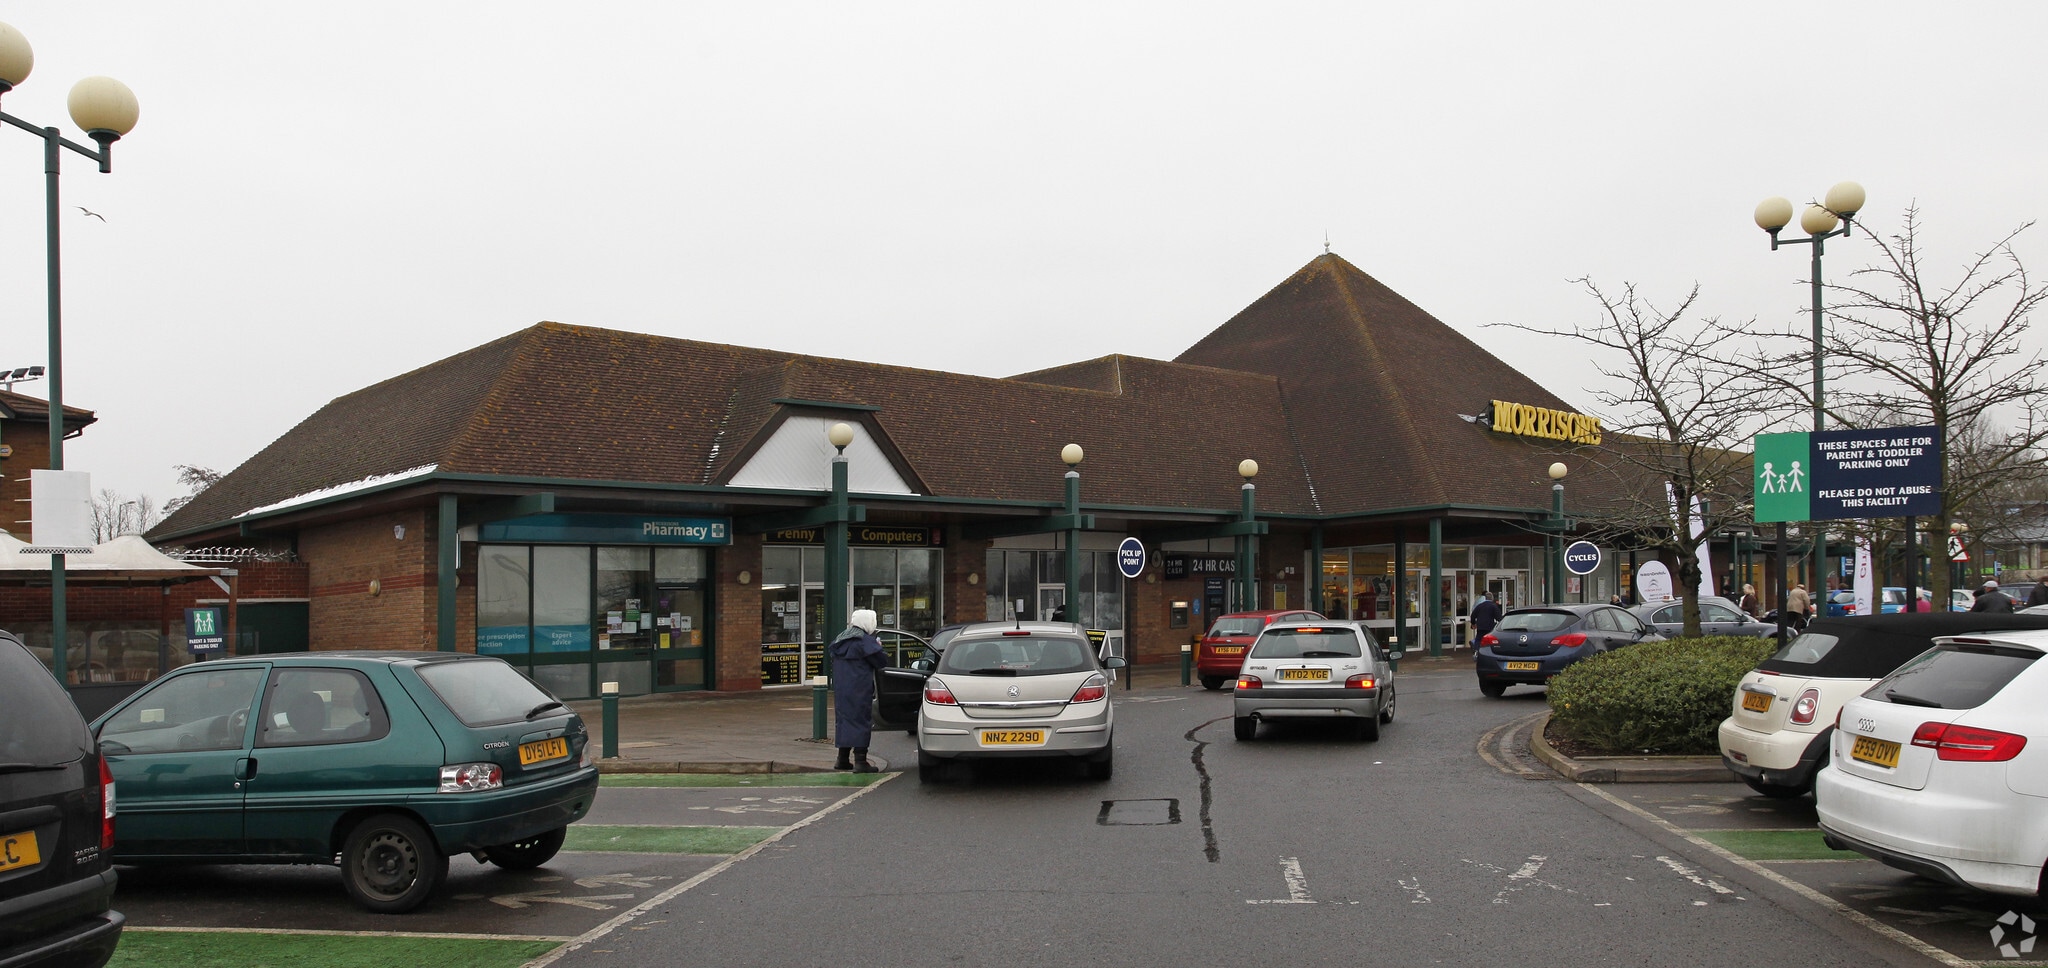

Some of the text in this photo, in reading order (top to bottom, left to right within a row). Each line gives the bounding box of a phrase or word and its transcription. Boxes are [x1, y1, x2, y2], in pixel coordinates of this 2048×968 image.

[1492, 399, 1602, 446] MORRISONS
[1818, 437, 1932, 451] THESE SPACES ARE FOR
[1826, 448, 1923, 460] PARENT & TODDLER
[1839, 458, 1910, 470] PARKING ONLY
[1818, 485, 1932, 499] PLEASE DO NOT ABUSE
[1841, 496, 1909, 508] THIS FACILITY
[643, 521, 708, 540] Pharmacy
[777, 529, 815, 542] Penny
[861, 528, 923, 543] Computers
[1121, 549, 1142, 557] PICK UP
[1568, 553, 1597, 562] CYCLES
[1123, 558, 1140, 566] POINT
[1192, 559, 1235, 572] 24 HR CAS
[486, 633, 526, 641] prescription
[1311, 670, 1328, 679] YGE
[986, 732, 1040, 742] NNZ 2290
[525, 740, 562, 761] DY51 LFV
[1853, 738, 1877, 758] EF59
[1876, 742, 1900, 763] OVV
[74, 845, 99, 857] ZAFIRA
